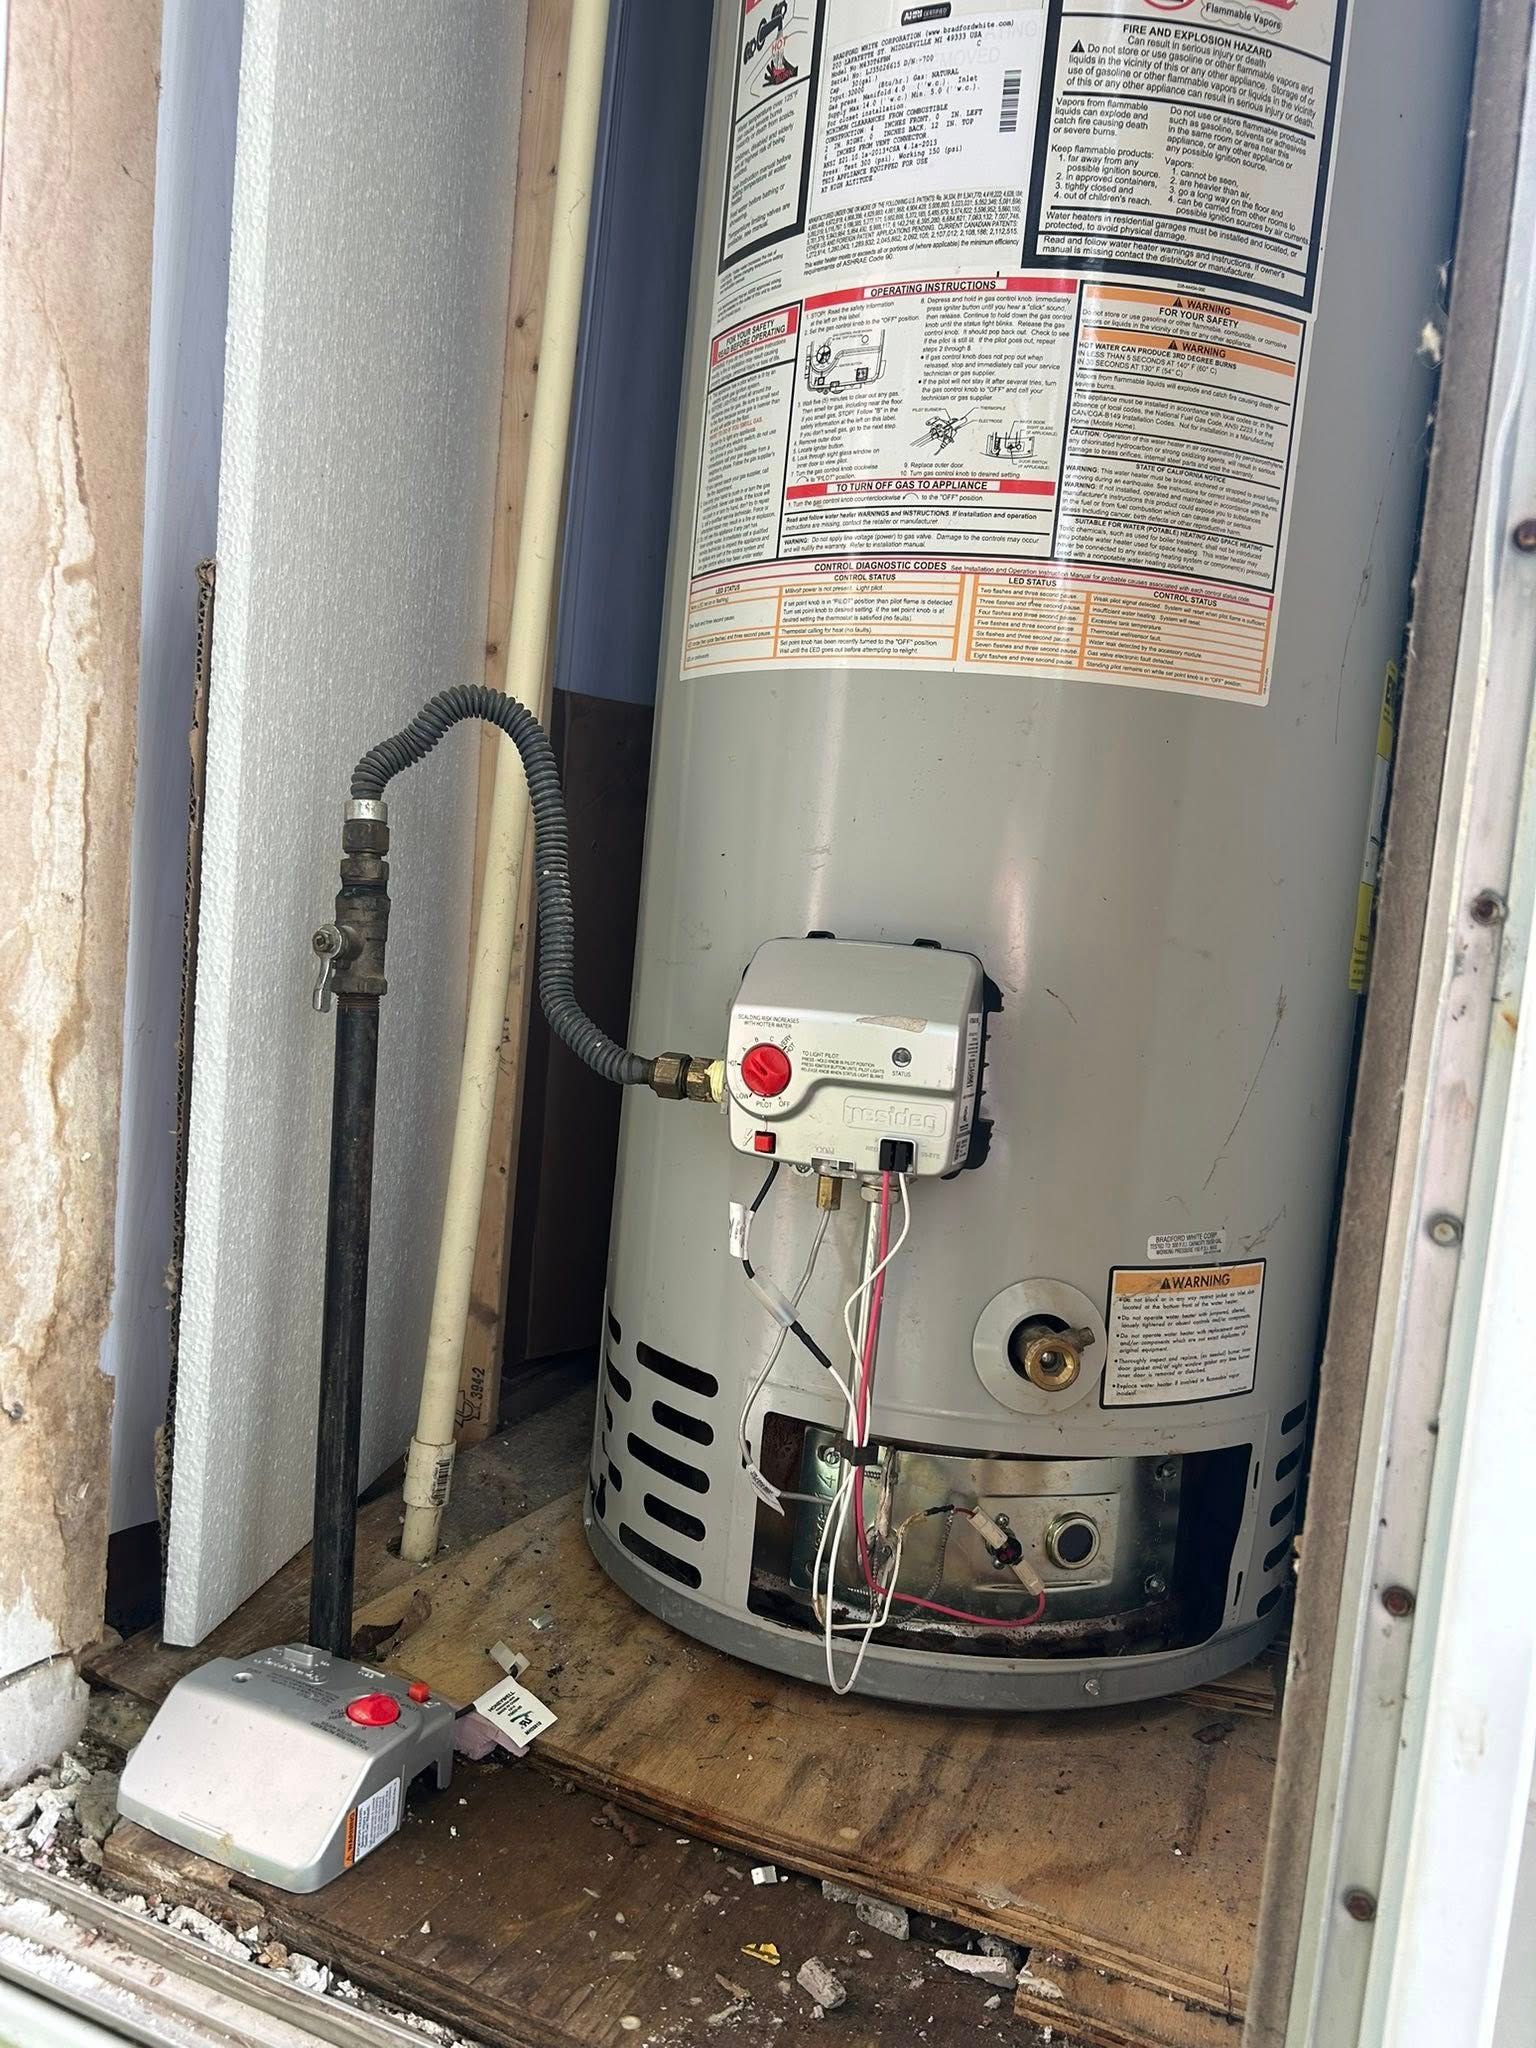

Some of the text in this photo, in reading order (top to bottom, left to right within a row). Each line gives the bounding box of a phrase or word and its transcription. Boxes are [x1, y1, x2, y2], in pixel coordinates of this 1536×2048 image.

[1206, 3, 1280, 29] Flammable Vapors
[772, 37, 786, 53] HOT
[861, 41, 878, 51] WHITE
[881, 31, 921, 46] CORPORATION
[1123, 24, 1272, 58] FIRE AND EXPLOSION HAZARD
[1128, 36, 1145, 45] Can
[1147, 39, 1170, 48] result
[1182, 44, 1210, 55] serious
[1213, 48, 1234, 61] injury
[1245, 56, 1266, 67] death
[1069, 55, 1095, 65] liquids
[1098, 56, 1104, 64] in
[1108, 57, 1120, 65] the
[1124, 59, 1151, 69] vicinity
[1154, 60, 1162, 68] of
[1165, 62, 1178, 71] this
[1191, 67, 1205, 77] any
[1208, 70, 1228, 80] other
[1230, 75, 1267, 91] appliance.
[1271, 84, 1298, 100] Storage
[1088, 44, 1100, 53] Do
[1102, 46, 1115, 54] not
[1118, 48, 1138, 56] store
[1169, 52, 1202, 64] gasoline
[1215, 60, 1235, 71] other
[1237, 64, 1274, 80] flammable
[1276, 75, 1299, 89] vapors
[1301, 84, 1313, 95] and
[1086, 66, 1094, 74] of
[1096, 68, 1131, 77] gasoline
[1168, 74, 1208, 88] flammable
[1211, 81, 1237, 94] vapors
[1248, 89, 1271, 103] liquids
[1273, 96, 1279, 104] in
[1281, 98, 1292, 108] the
[1294, 103, 1316, 119] vicinity
[1056, 97, 1085, 106] Vapors
[1107, 99, 1148, 111] flammable
[1055, 107, 1081, 116] liquids
[1100, 110, 1131, 118] explode
[1133, 112, 1148, 120] and
[1078, 117, 1091, 125] fire
[1093, 119, 1123, 129] causing
[1126, 121, 1148, 129] death
[902, 159, 913, 168] FOR
[870, 281, 996, 298] OPERATING INSTRUCTIONS
[1187, 300, 1231, 316] WARNING
[1159, 308, 1239, 328] FOR YOUR SAFETY
[726, 320, 775, 346] FOR YOUR SAFETY
[730, 339, 750, 352] BEFORE
[751, 325, 785, 343] OPERATING
[1095, 342, 1120, 351] WATER
[1138, 347, 1172, 357] PRODUCE
[1187, 354, 1213, 365] DEGREE
[1215, 360, 1237, 369] BURNS
[1183, 342, 1226, 358] WARNING
[1166, 467, 1203, 479] CALIFORNIA
[1204, 475, 1225, 483] NOTICE
[837, 483, 847, 491] TO
[851, 482, 872, 490] TURN
[896, 481, 914, 489] GAS
[918, 481, 930, 489] TO
[932, 481, 987, 489] APPLIANCE
[814, 562, 946, 572] CONTROL DIAGNOSTIC CODES
[869, 573, 896, 581] STATUS
[1027, 579, 1057, 587] STATUS
[1154, 591, 1217, 607] CONTROL STATUS
[846, 1106, 936, 1132] resideo
[1156, 1235, 1185, 1243] BRADFORD
[1186, 1233, 1202, 1241] WHITE
[1171, 1274, 1231, 1288] WARNING
[471, 1368, 485, 1399] 394-2
[488, 1692, 515, 1712] HONEYWELL
